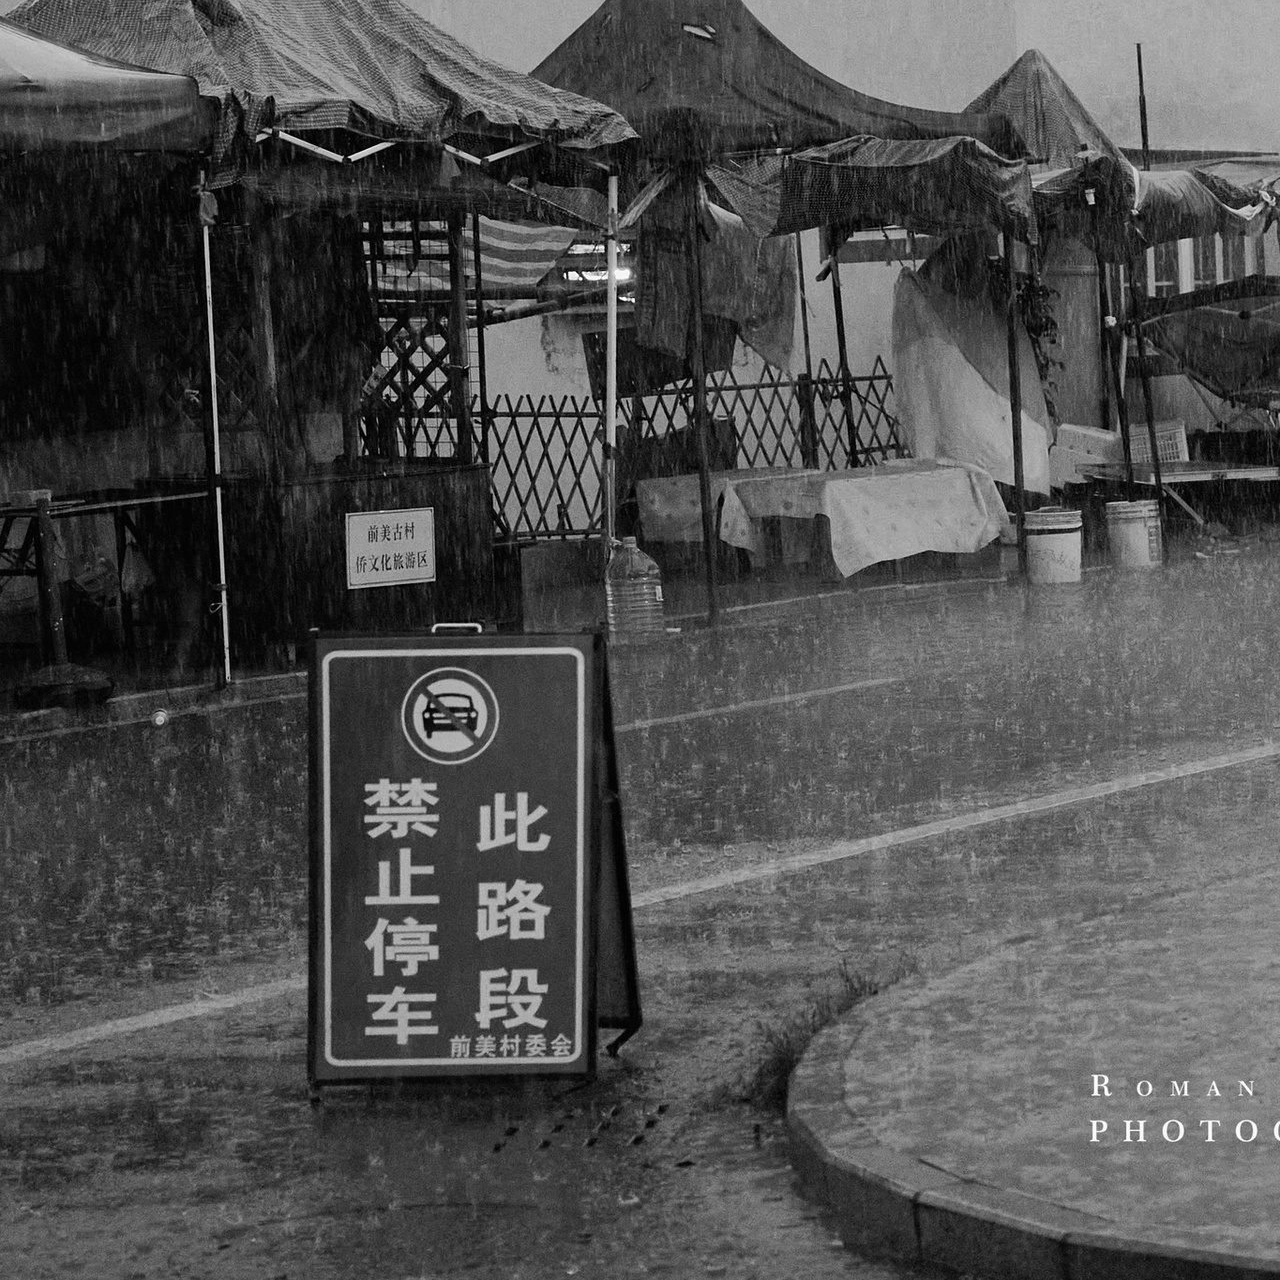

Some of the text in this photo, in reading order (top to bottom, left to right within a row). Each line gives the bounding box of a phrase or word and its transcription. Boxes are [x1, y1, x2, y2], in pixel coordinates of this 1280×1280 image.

[368, 522, 415, 543] 前美古村
[356, 550, 428, 574] 侨文化旅游区
[364, 778, 440, 1045] 禁止停车
[475, 791, 551, 1030] 此路段
[450, 1033, 572, 1058] 前美村委会
